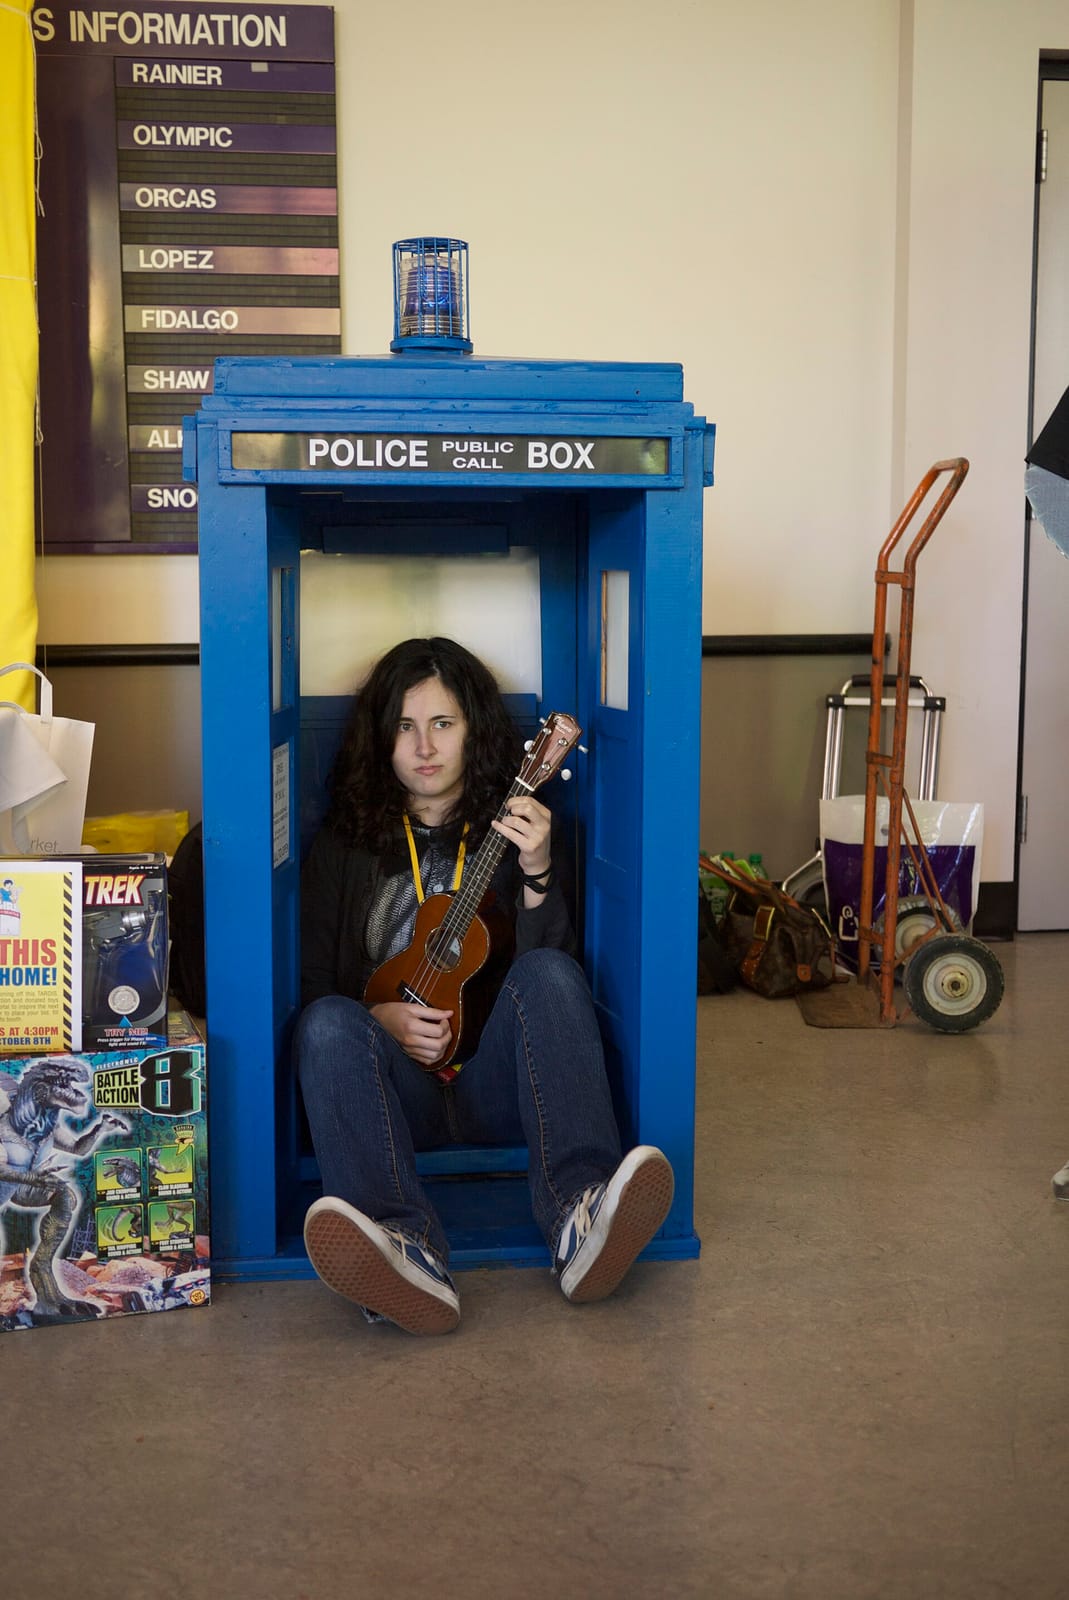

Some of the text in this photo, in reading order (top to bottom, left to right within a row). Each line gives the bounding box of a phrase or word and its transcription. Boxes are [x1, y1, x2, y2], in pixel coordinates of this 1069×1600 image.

[33, 8, 287, 47] S INFORMATION
[132, 63, 222, 86] RAINIER
[133, 124, 233, 148] OLYMPIC
[135, 187, 217, 209] ORCAS
[139, 249, 214, 269] LOPEZ
[141, 309, 239, 331] FIDALGO
[143, 370, 210, 390] SHAW
[309, 438, 428, 467] POLICE
[442, 441, 514, 453] PUBLIC
[528, 441, 595, 469] BOX
[452, 457, 503, 469] CALL
[147, 487, 199, 508] SNO
[85, 875, 144, 904] TREK
[0, 939, 57, 966] THIS
[0, 967, 57, 986] HOME!
[0, 1036, 51, 1045] TOBER 8TH
[9, 1027, 20, 1036] AT
[24, 1026, 59, 1036] 4:30PM
[104, 1028, 125, 1037] TRY
[97, 1069, 139, 1088] BATTLE
[141, 1050, 201, 1116] 8
[96, 1087, 139, 1104] ACTION
